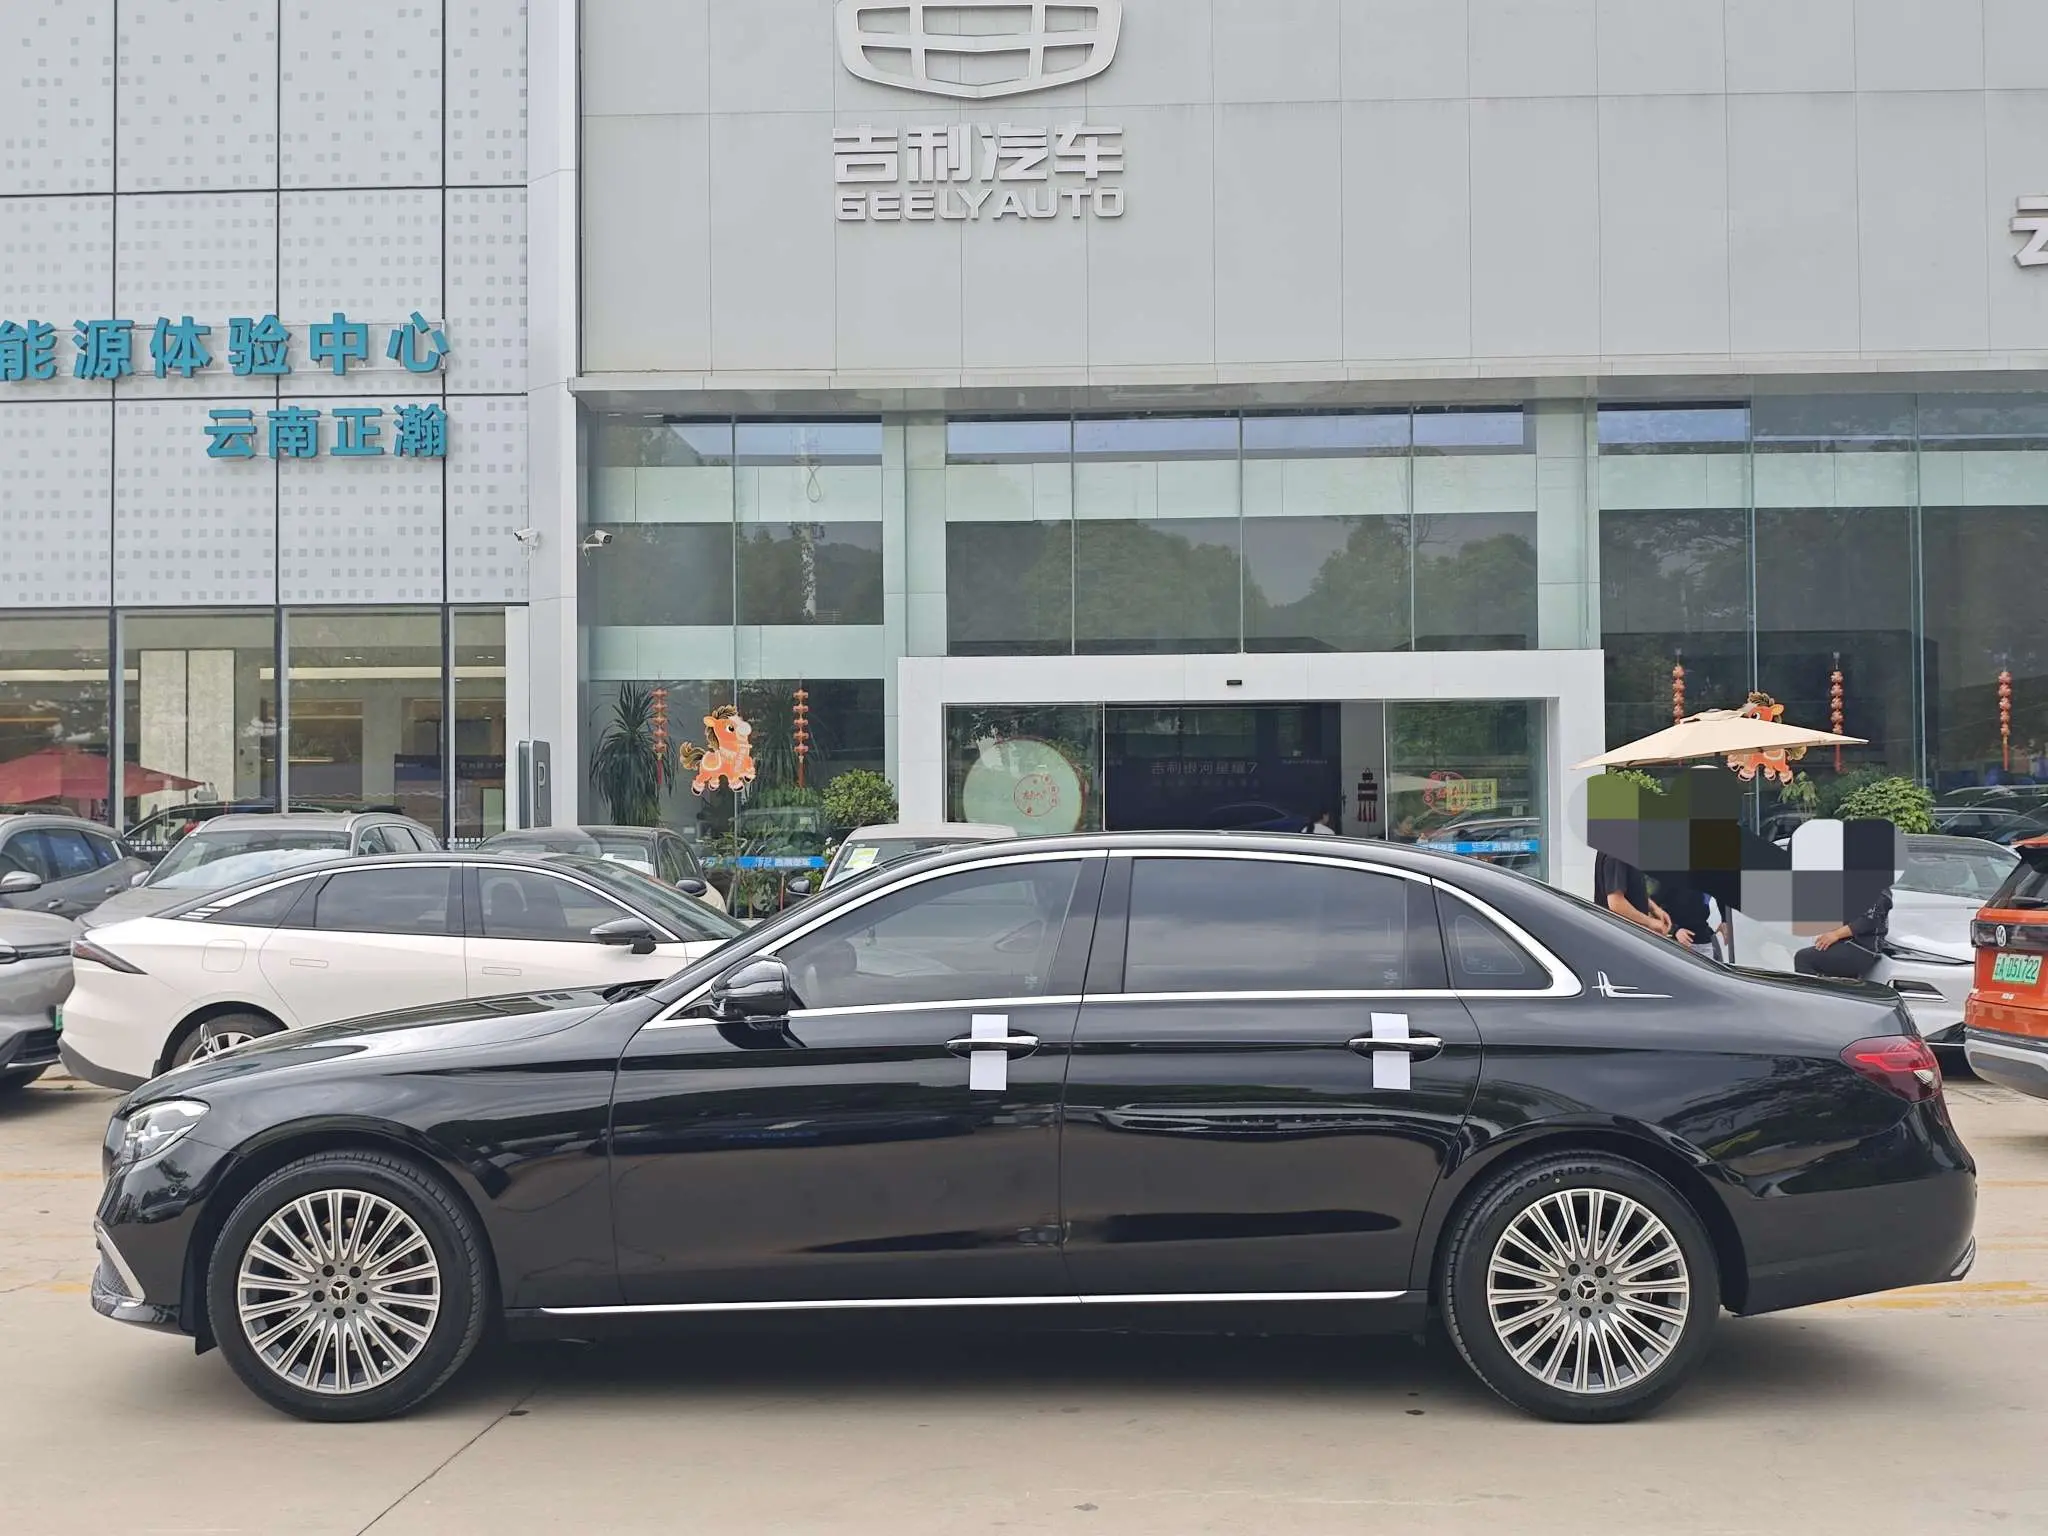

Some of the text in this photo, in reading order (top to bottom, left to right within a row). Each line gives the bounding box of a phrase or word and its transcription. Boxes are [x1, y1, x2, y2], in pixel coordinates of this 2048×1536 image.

[833, 122, 1124, 182] 吉利汽车
[0, 312, 450, 382] 能源体验中心
[204, 403, 448, 459] 云南正瀚
